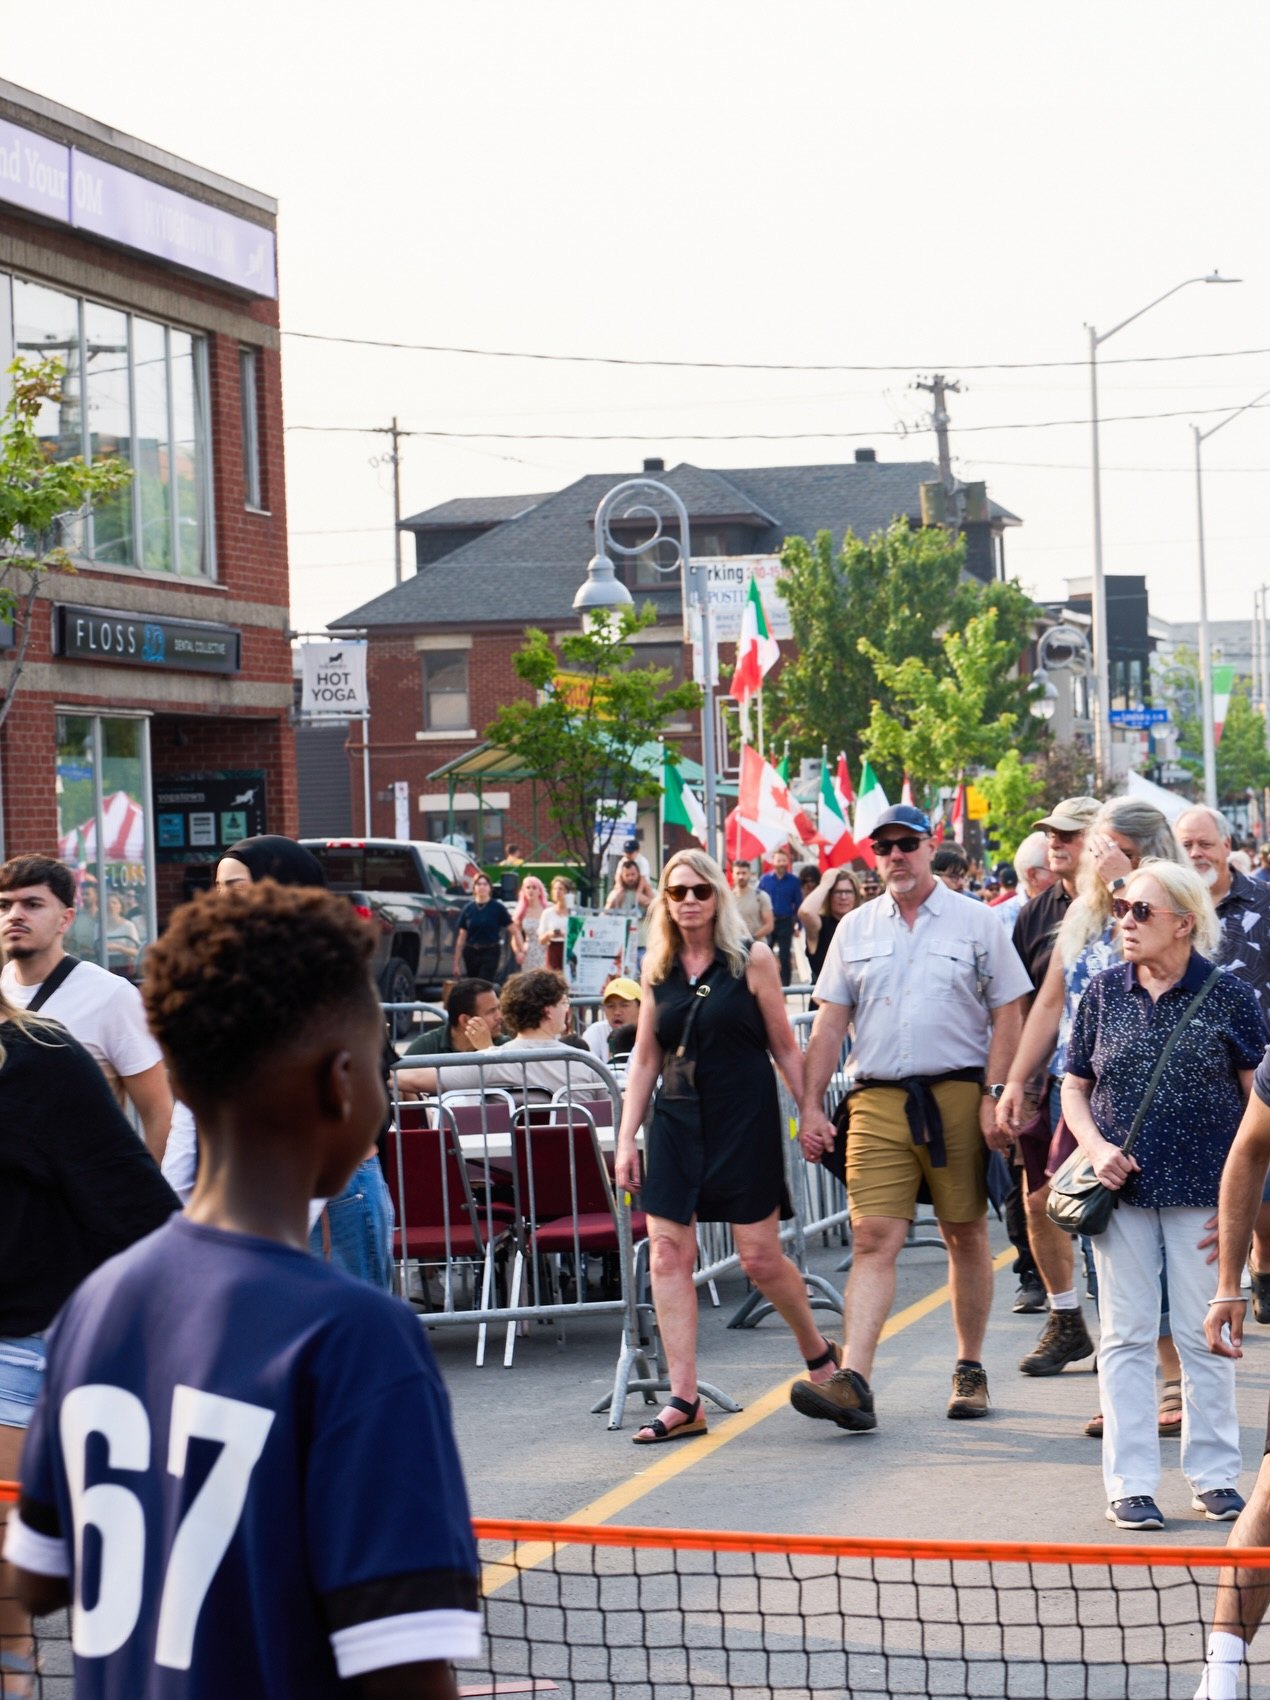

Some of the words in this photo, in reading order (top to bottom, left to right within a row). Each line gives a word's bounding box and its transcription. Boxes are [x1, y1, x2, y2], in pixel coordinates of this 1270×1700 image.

[24, 147, 67, 200] Your
[74, 170, 103, 216] OM
[76, 619, 136, 653] FLOSS
[174, 639, 194, 653] DENTAL
[195, 641, 227, 655] COLLECTIVE
[312, 688, 357, 702] YOGA
[317, 672, 351, 686] HOT
[60, 1384, 275, 1670] 67
